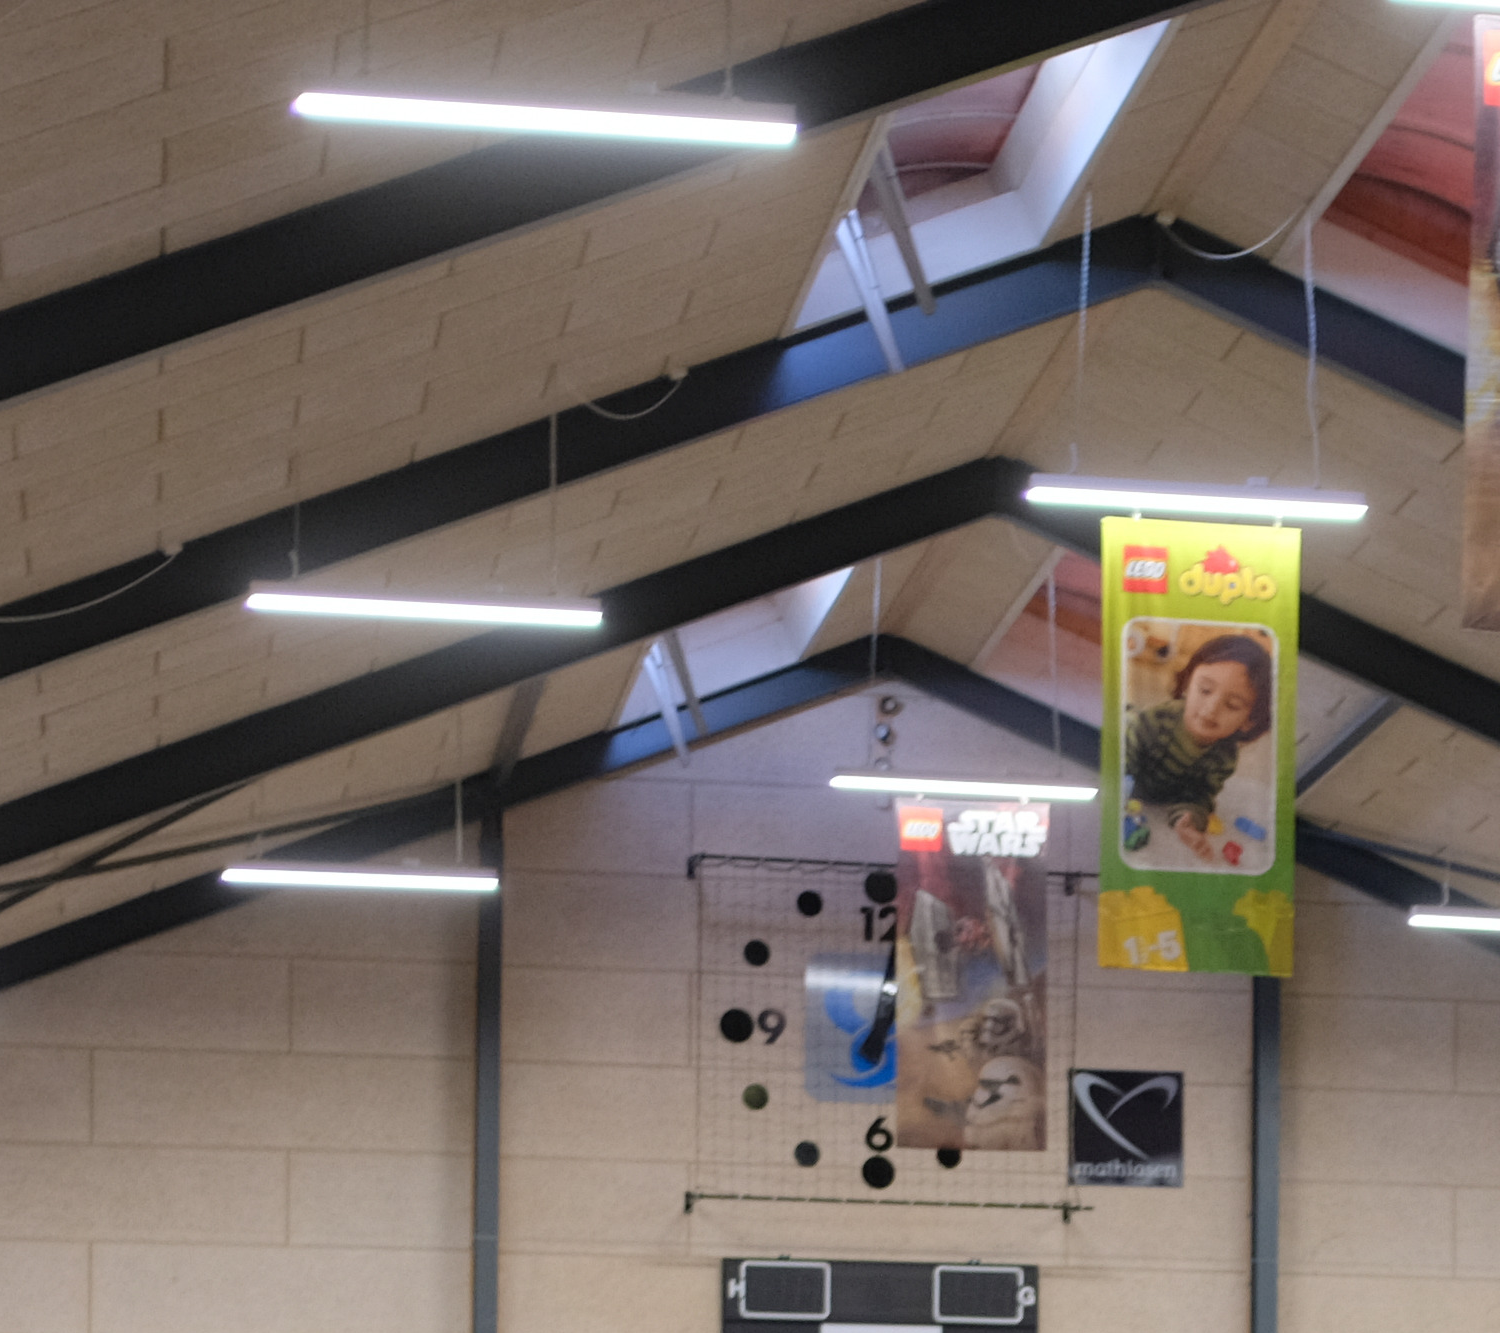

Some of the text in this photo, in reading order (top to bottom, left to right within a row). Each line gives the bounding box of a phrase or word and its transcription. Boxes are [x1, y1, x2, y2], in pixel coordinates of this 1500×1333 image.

[1124, 558, 1278, 605] LEGO duplo
[902, 818, 942, 842] LEGO
[949, 810, 1047, 834] STAR
[949, 832, 1046, 857] WARS
[860, 906, 897, 943] 12
[757, 1010, 786, 1045] 9
[866, 1116, 894, 1152] 6
[728, 1280, 744, 1300] H
[1018, 1286, 1036, 1305] G
